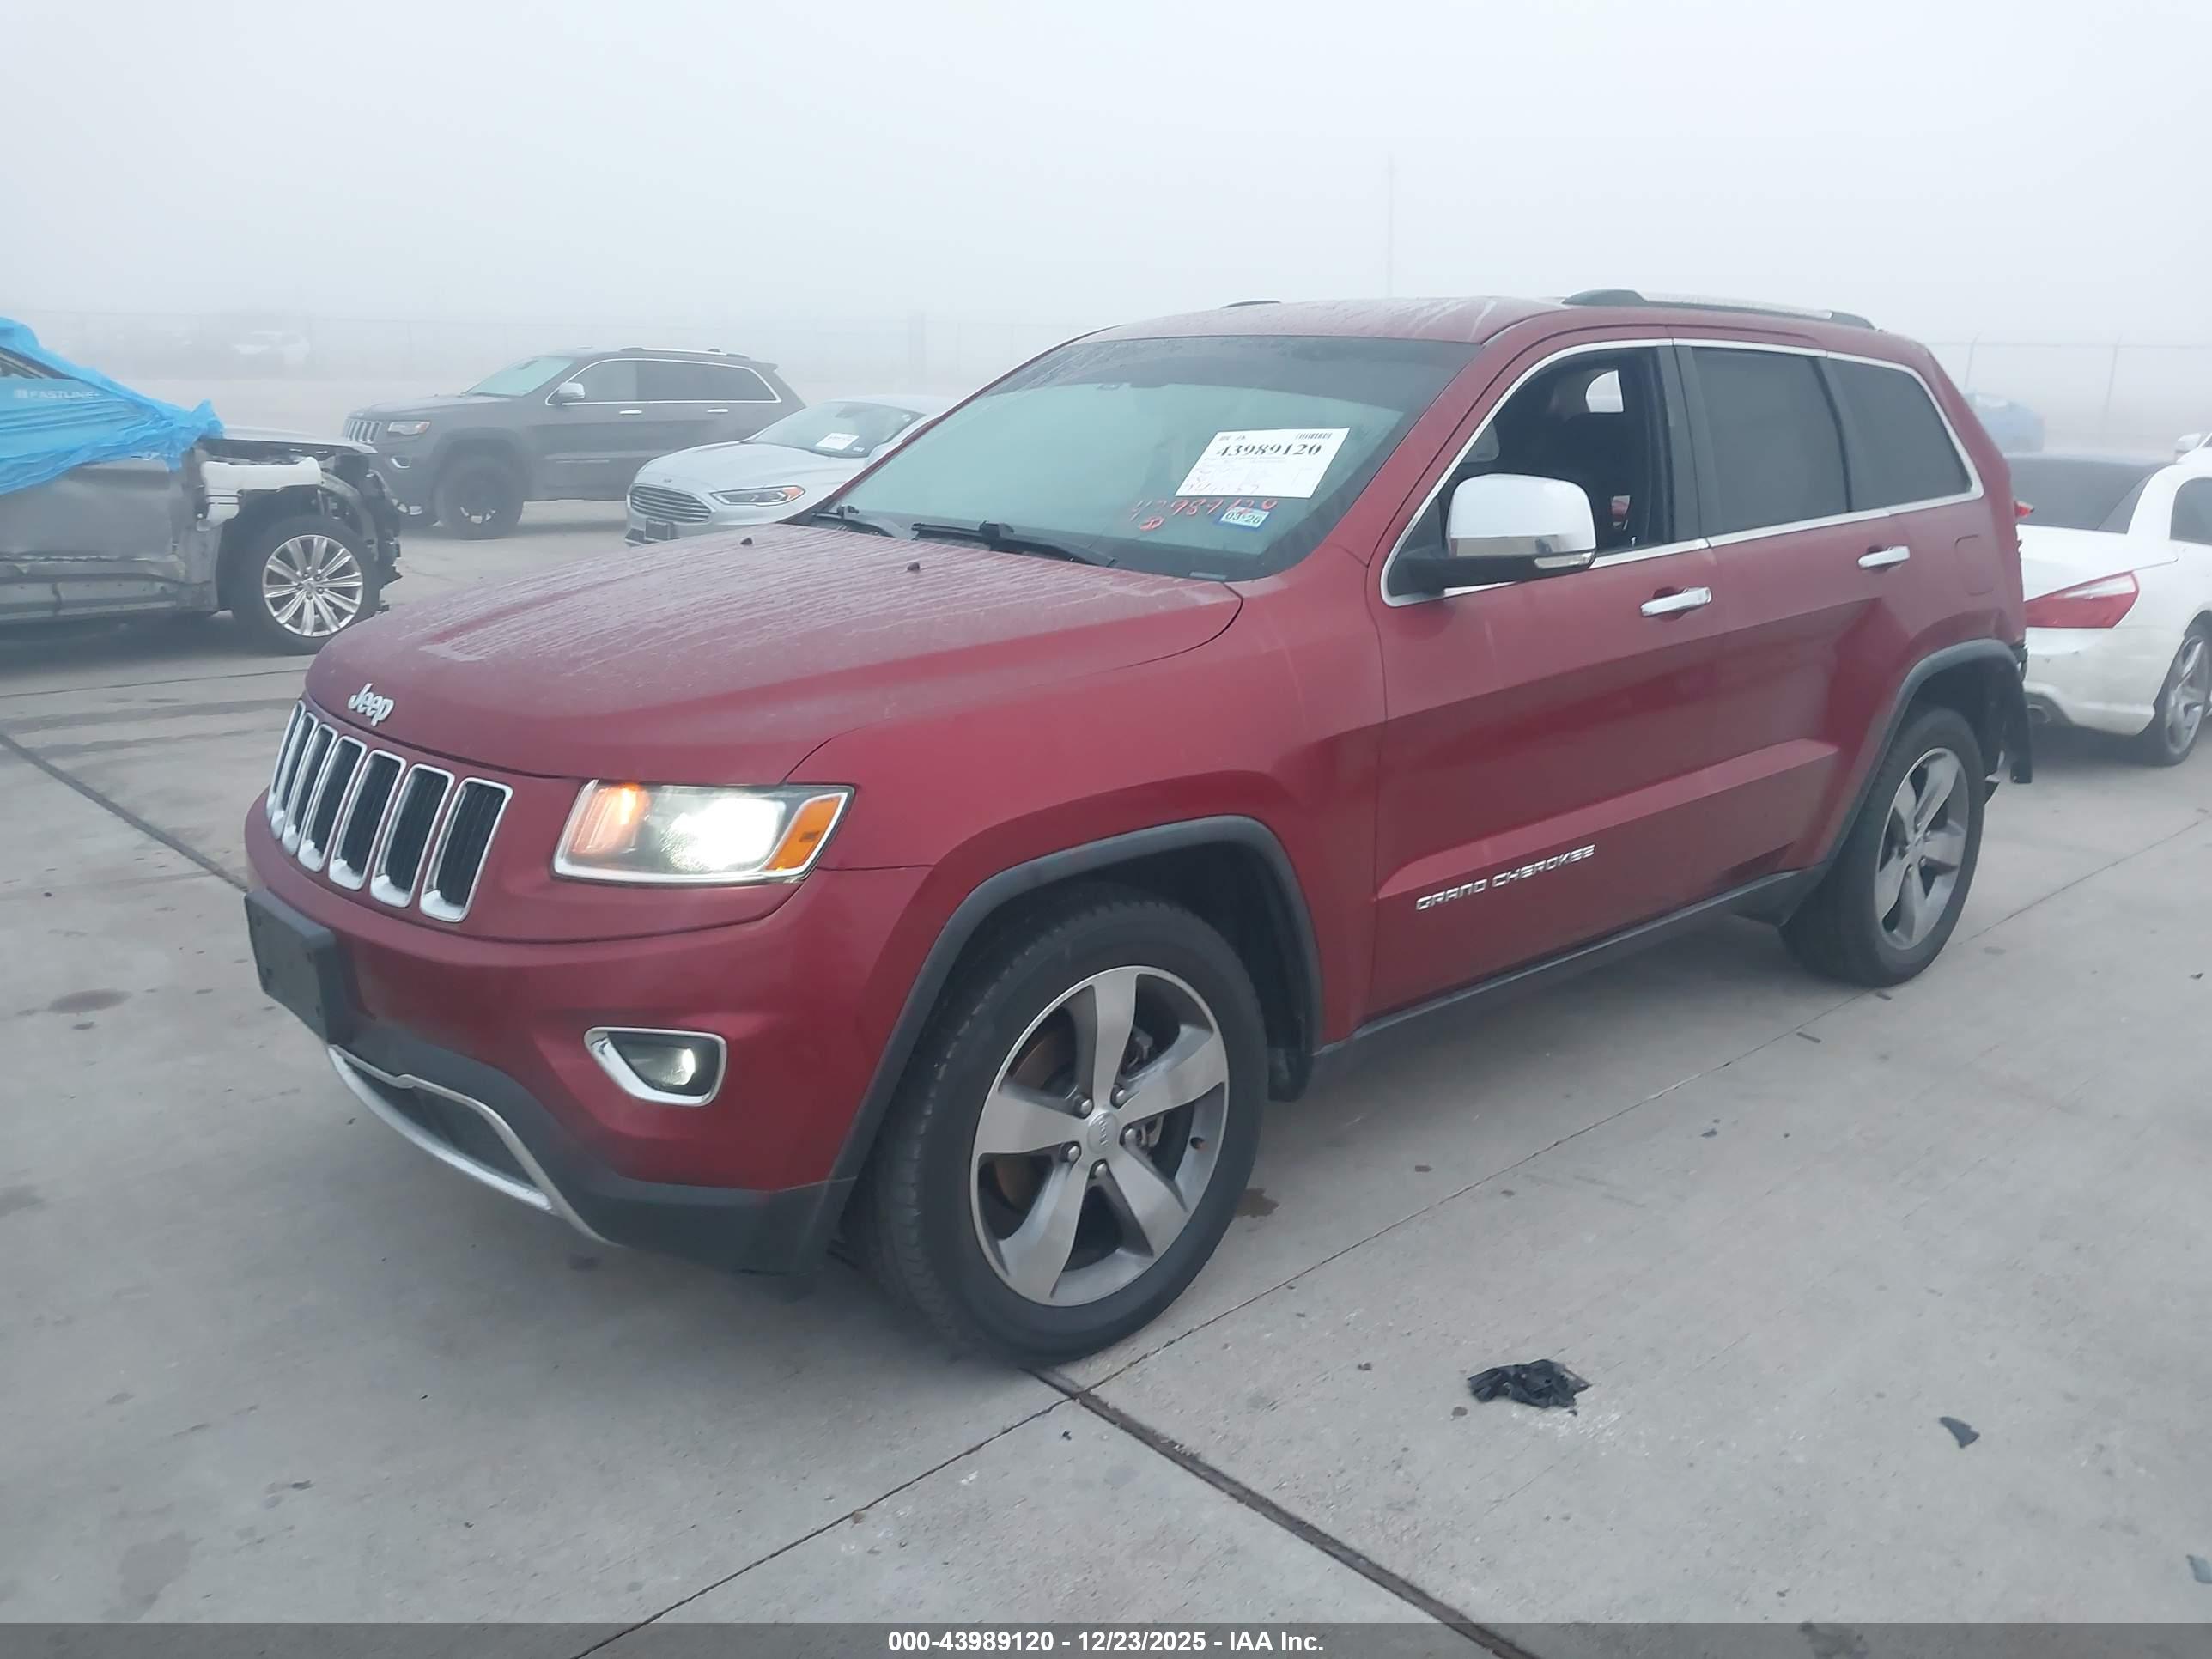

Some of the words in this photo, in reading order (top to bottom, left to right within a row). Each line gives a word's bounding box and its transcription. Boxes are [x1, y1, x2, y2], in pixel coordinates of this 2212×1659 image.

[1216, 443, 1322, 457] 43989120
[348, 683, 394, 726] Jeep
[1416, 878, 1488, 911] GRAND
[1492, 844, 1596, 888] CHEROKEE
